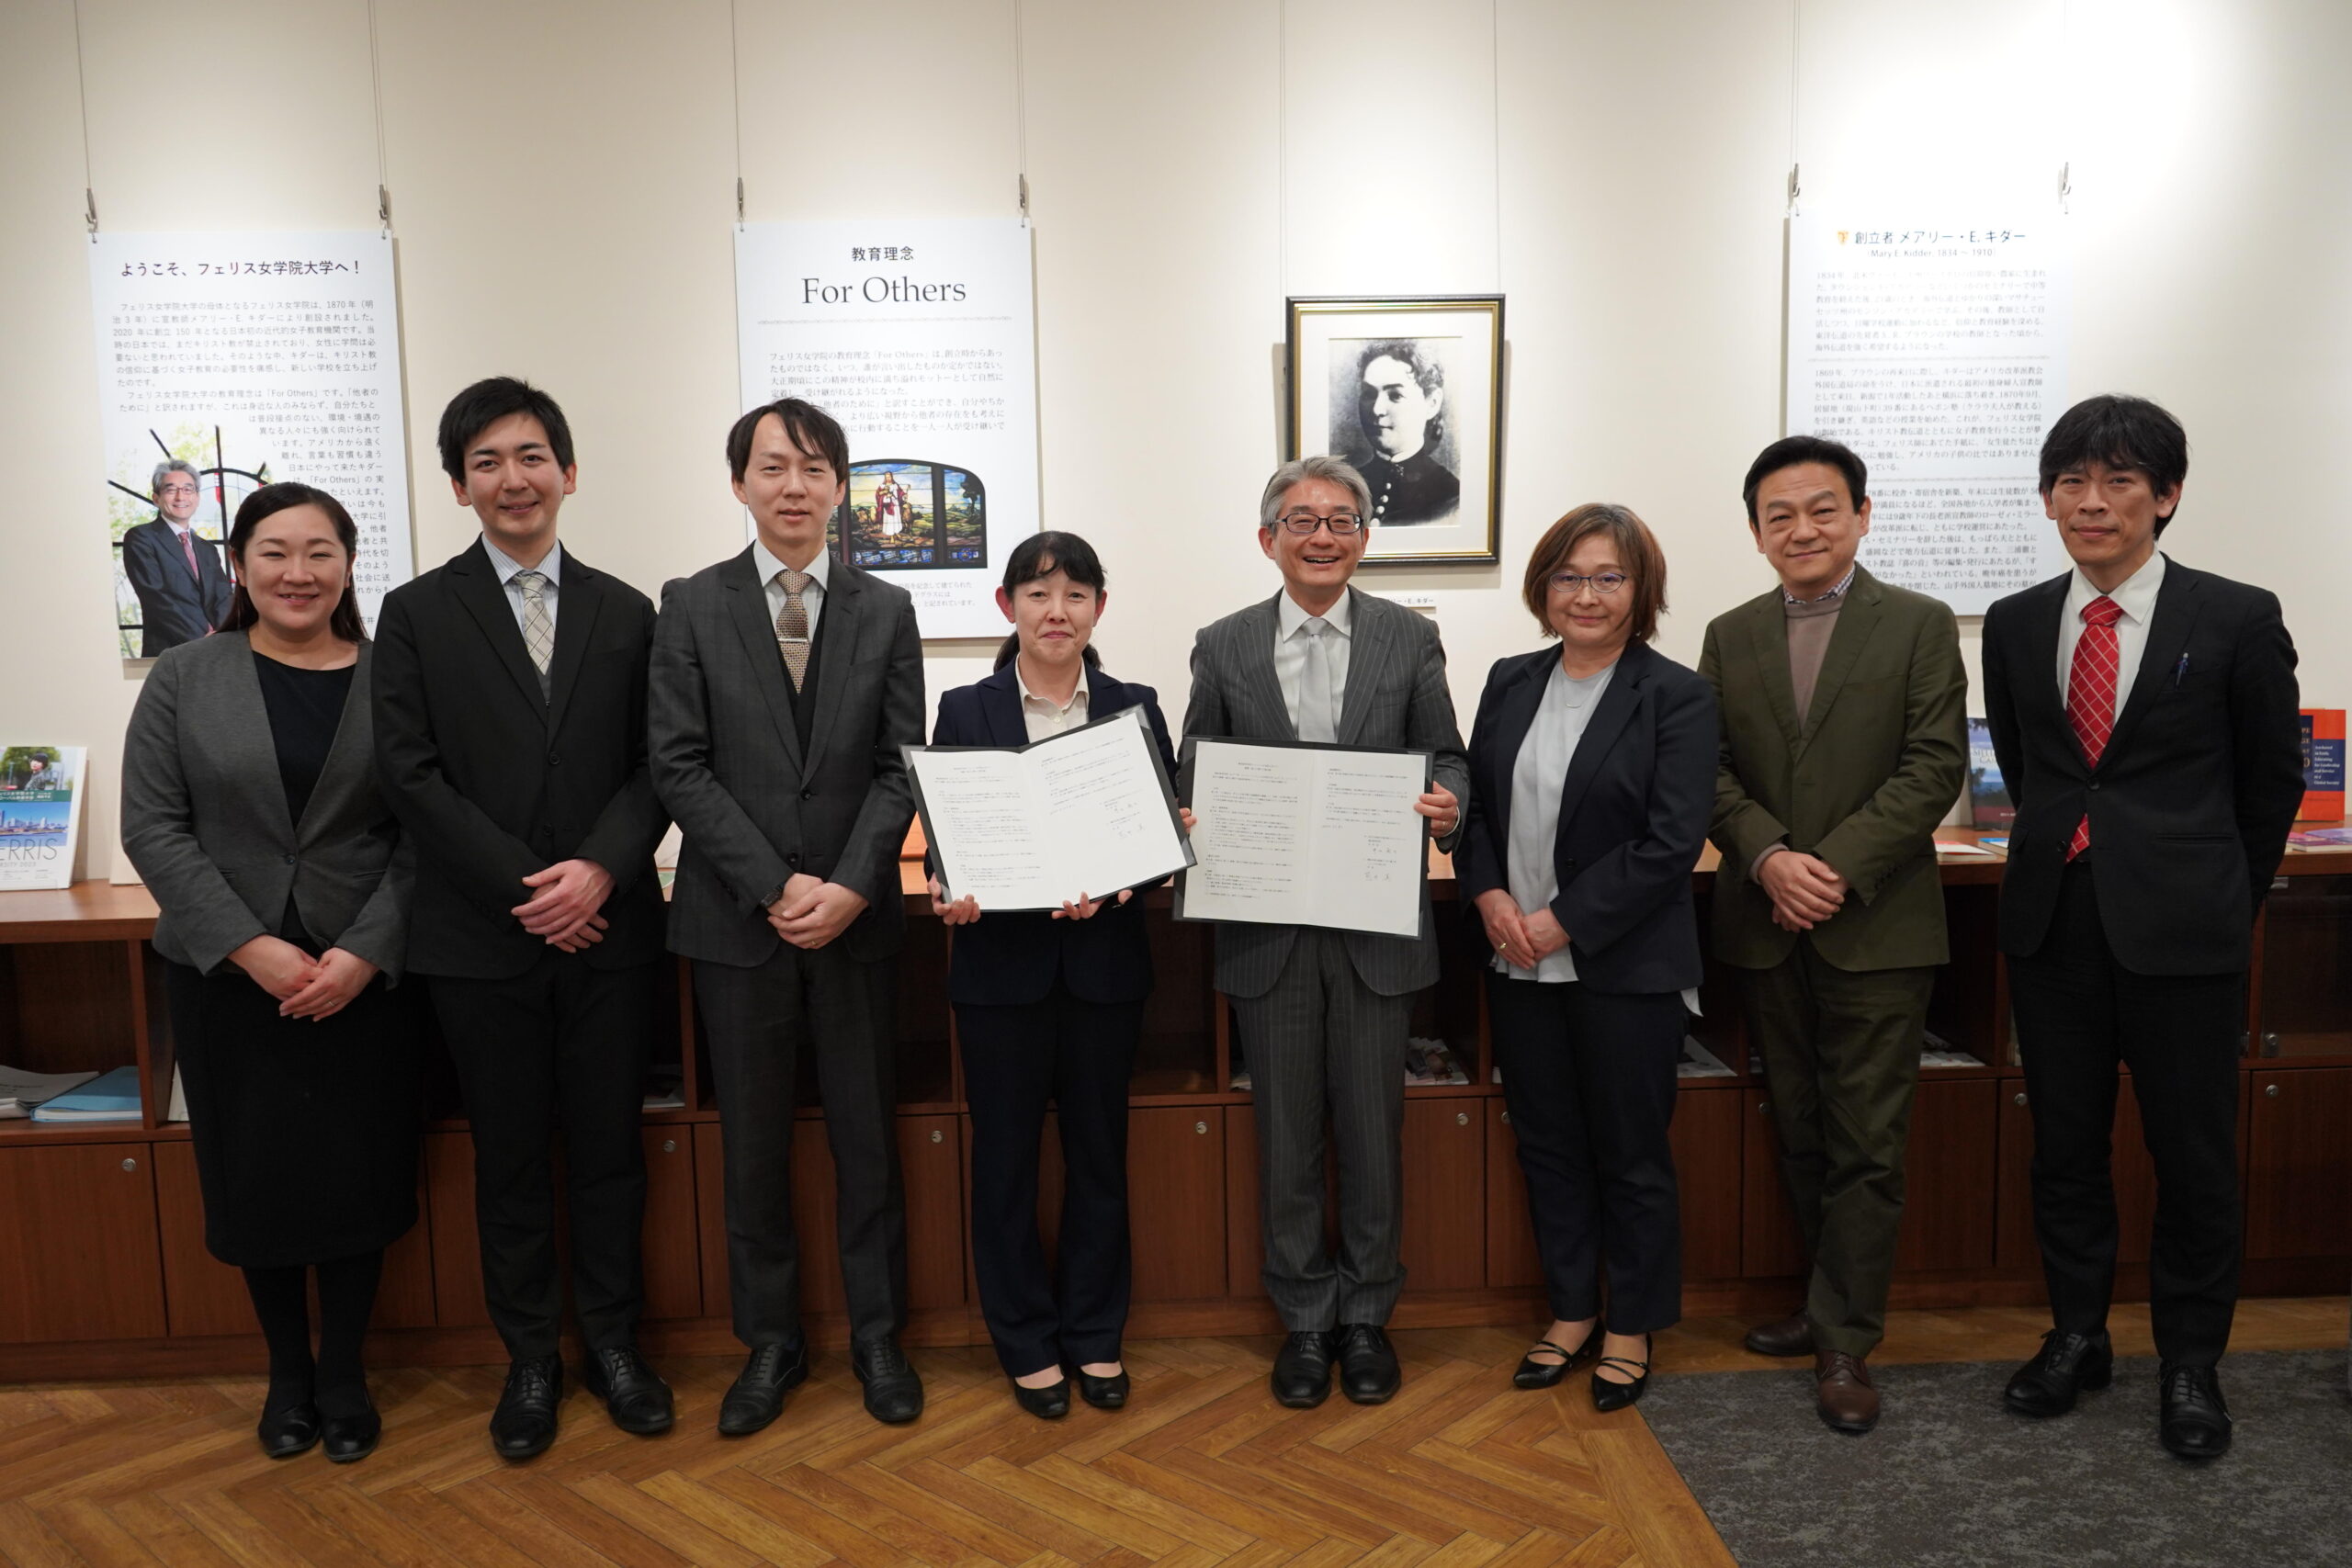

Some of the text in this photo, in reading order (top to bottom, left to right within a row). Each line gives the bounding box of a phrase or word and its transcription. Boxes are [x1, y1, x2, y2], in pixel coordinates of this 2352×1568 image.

[1855, 231, 1894, 245] 創立者
[1984, 229, 2026, 243] キダー
[851, 246, 914, 262] 教育理念
[1938, 248, 1958, 257] 1834
[801, 275, 967, 304] For Others
